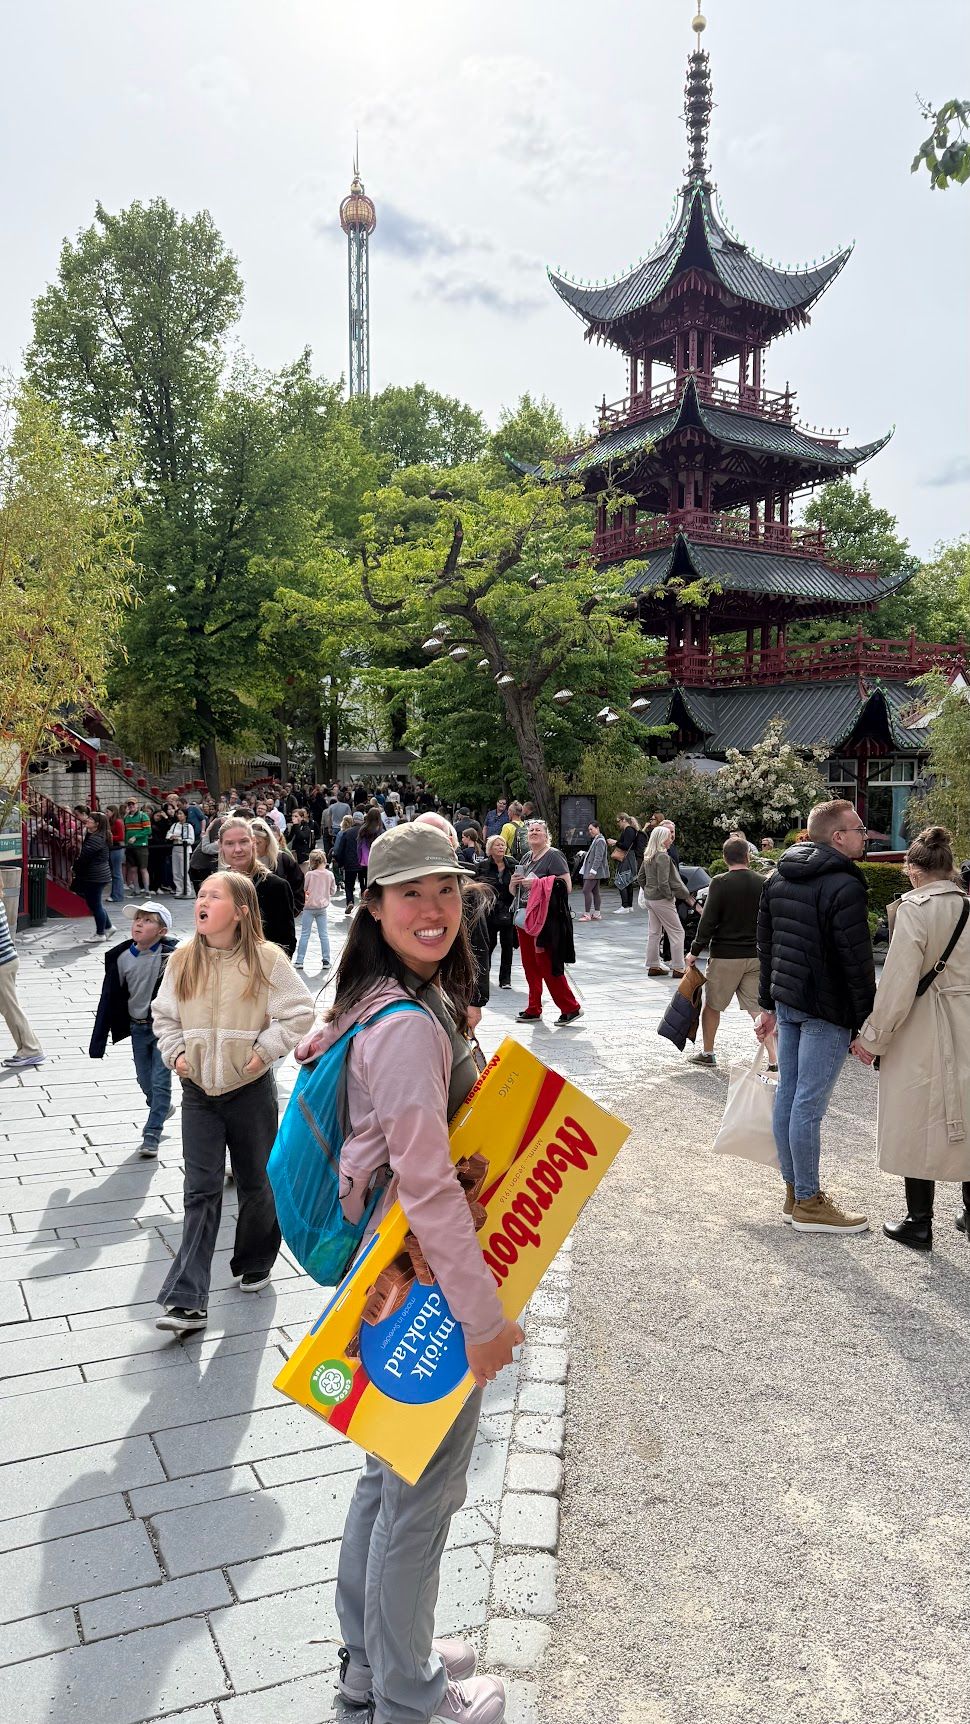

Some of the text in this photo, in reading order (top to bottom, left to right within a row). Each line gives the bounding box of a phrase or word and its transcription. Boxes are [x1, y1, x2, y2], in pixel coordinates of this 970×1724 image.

[465, 1054, 501, 1105] Marabou
[498, 1083, 511, 1098] KG
[510, 1164, 526, 1187] sedan
[483, 1115, 598, 1287] Marabou
[499, 1188, 513, 1203] 1916
[401, 1296, 416, 1318] made
[380, 1324, 401, 1350] Sweden
[384, 1292, 442, 1378] choklad
[410, 1316, 456, 1380] mjölk
[312, 1364, 325, 1381] LIFE
[334, 1379, 351, 1402] COCOA
